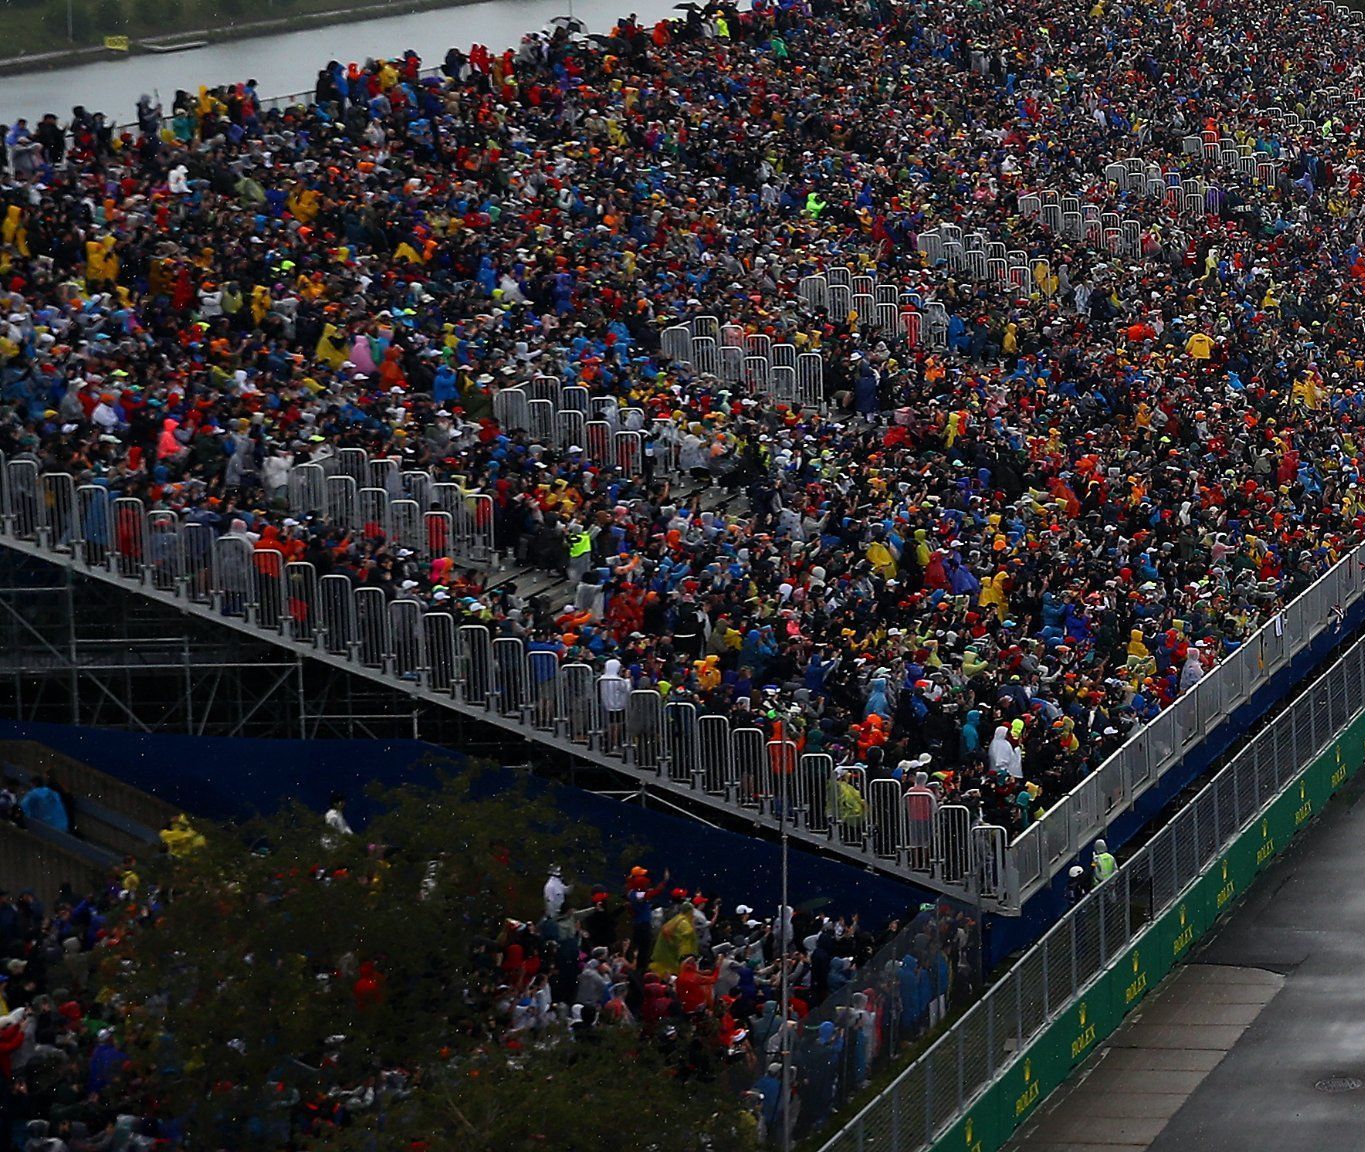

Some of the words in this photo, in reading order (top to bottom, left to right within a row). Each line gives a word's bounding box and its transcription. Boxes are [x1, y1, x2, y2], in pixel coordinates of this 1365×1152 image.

[1295, 801, 1313, 825] ROLEX
[1256, 838, 1274, 865] ROLEX
[1217, 881, 1235, 908] ROLEX
[1173, 924, 1194, 955] ROLEX
[1125, 971, 1147, 1004] ROLEX
[1071, 1023, 1096, 1059] ROLEX
[1015, 1080, 1040, 1116] ROLEX
